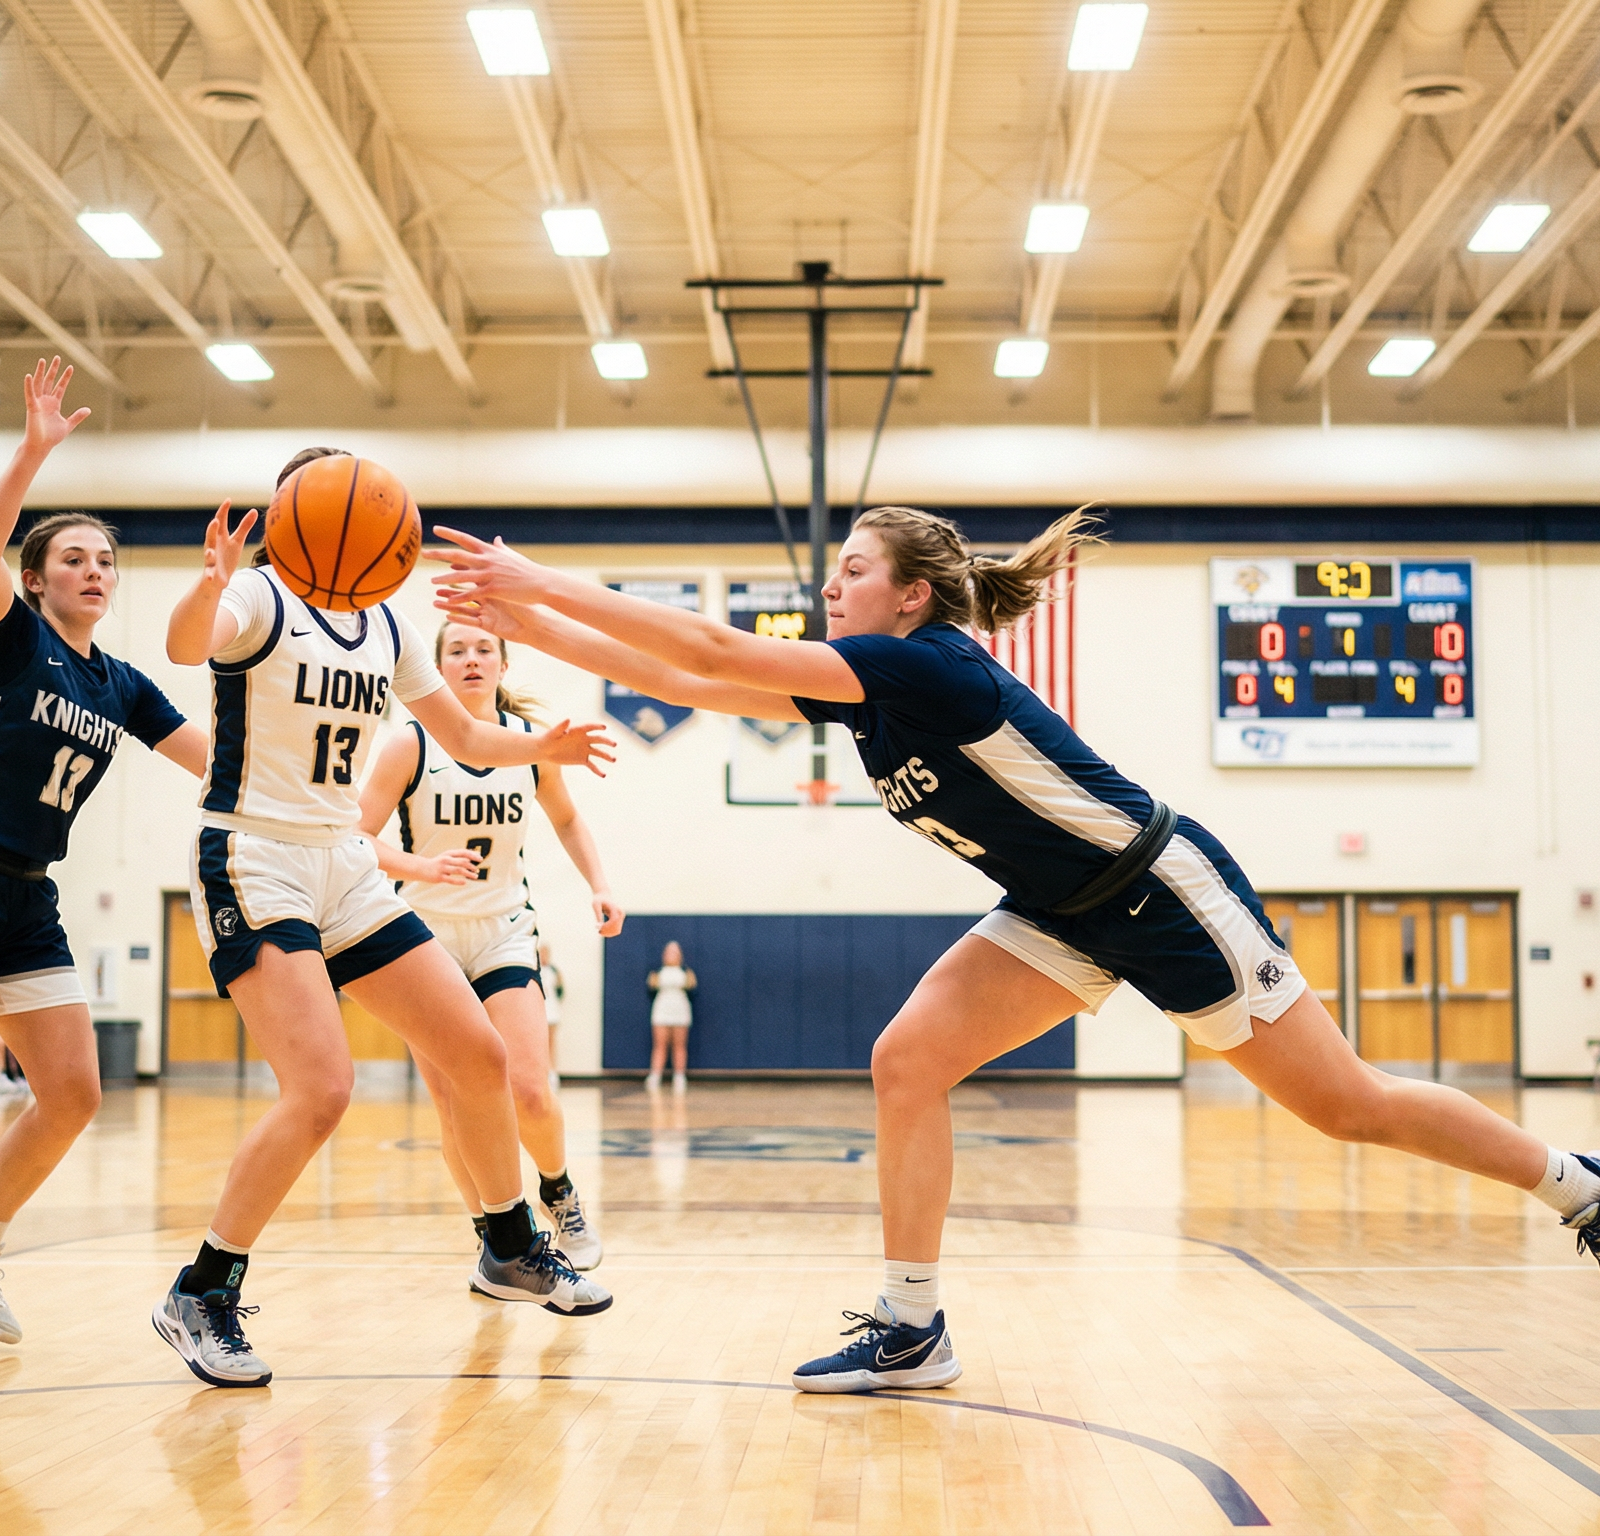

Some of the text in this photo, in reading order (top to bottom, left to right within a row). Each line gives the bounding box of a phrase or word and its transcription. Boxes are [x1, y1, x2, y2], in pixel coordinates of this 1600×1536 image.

[1259, 622, 1285, 661] 0
[1343, 628, 1355, 657] 1
[294, 661, 388, 716] LIONS
[1236, 673, 1257, 705] 0
[1443, 673, 1464, 705] 0
[30, 688, 124, 757] KNIGHTS
[309, 721, 361, 787] 13
[434, 792, 523, 825] LIONS
[465, 837, 492, 881] 2
